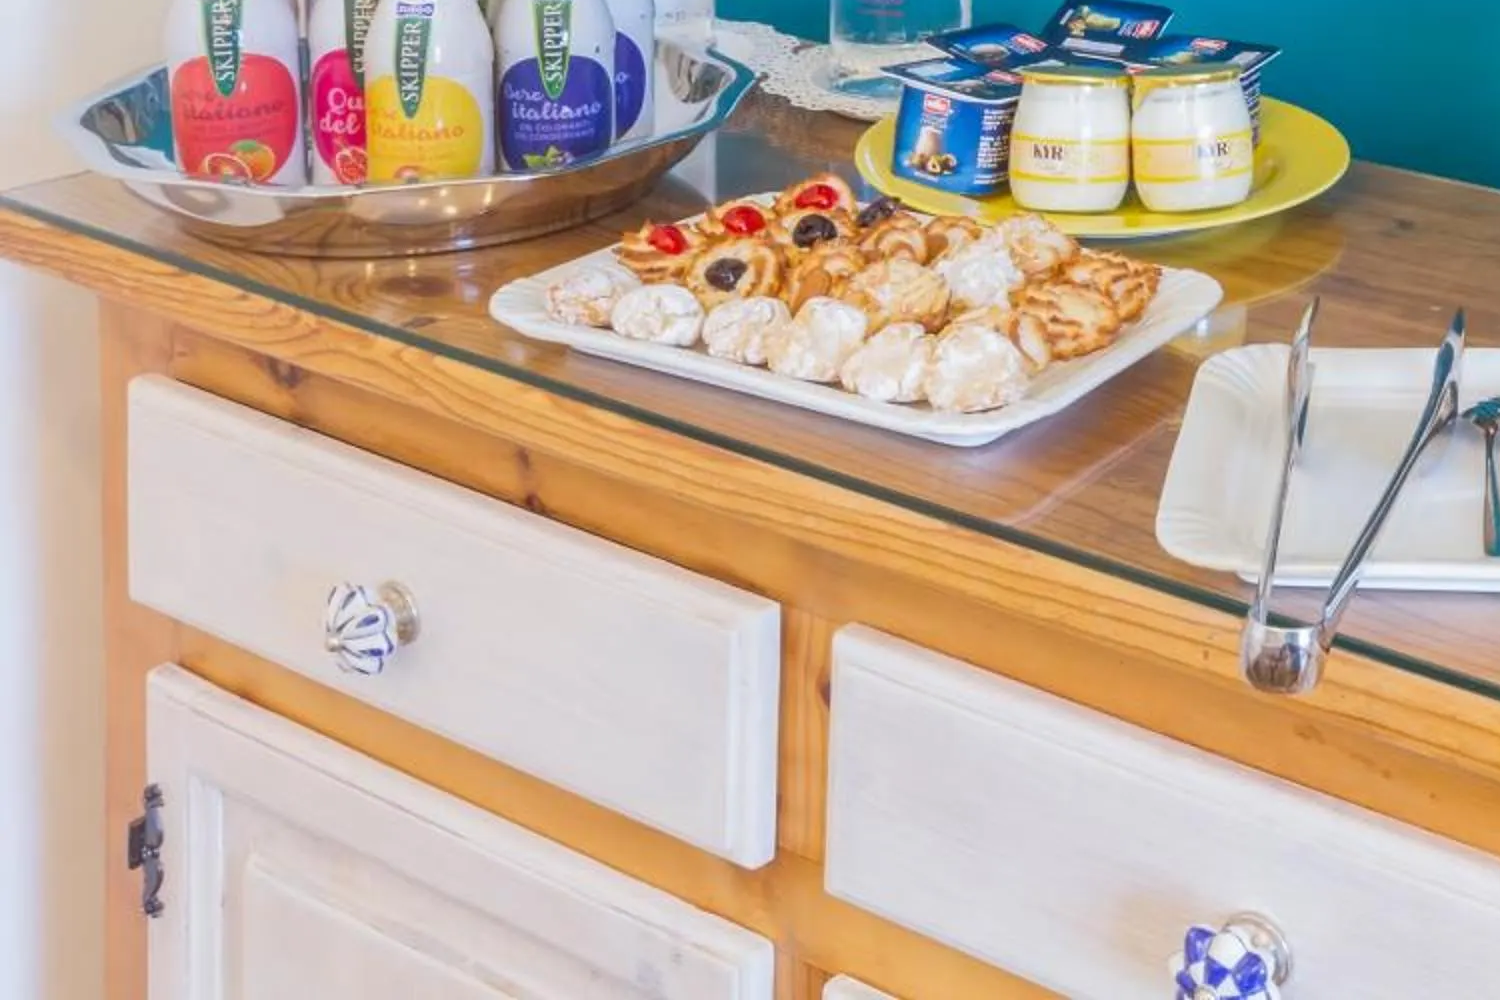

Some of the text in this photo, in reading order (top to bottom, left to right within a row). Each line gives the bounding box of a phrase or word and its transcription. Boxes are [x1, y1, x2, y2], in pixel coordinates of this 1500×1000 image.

[401, 21, 423, 102] SKIPPER
[544, 3, 565, 81] SKIPPER
[319, 111, 361, 135] del
[512, 101, 602, 121] italiano
